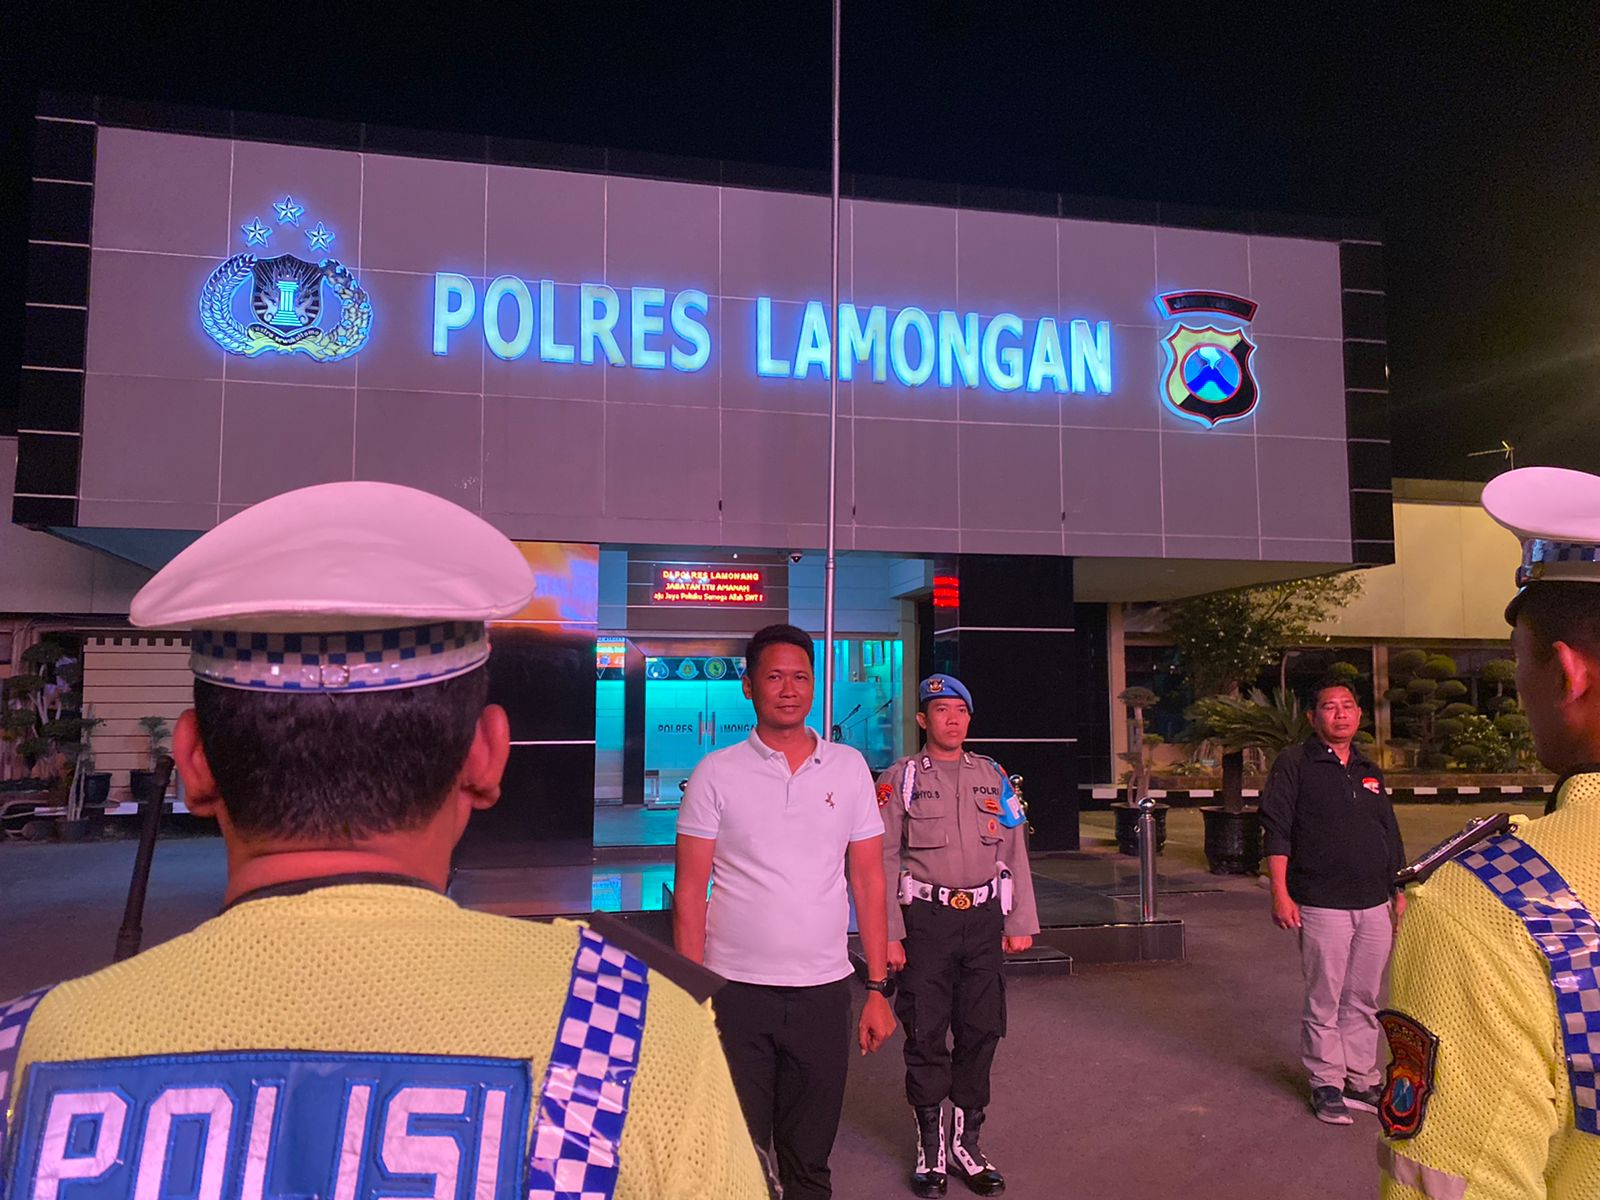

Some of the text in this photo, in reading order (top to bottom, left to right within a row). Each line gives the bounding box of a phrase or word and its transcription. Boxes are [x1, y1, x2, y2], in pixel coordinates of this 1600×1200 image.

[433, 271, 1113, 395] POLRES LAMONGAN
[675, 571, 708, 580] POLRES
[666, 583, 700, 591] JABATAN
[658, 724, 693, 733] POLRES
[32, 1086, 507, 1200] POLISI
